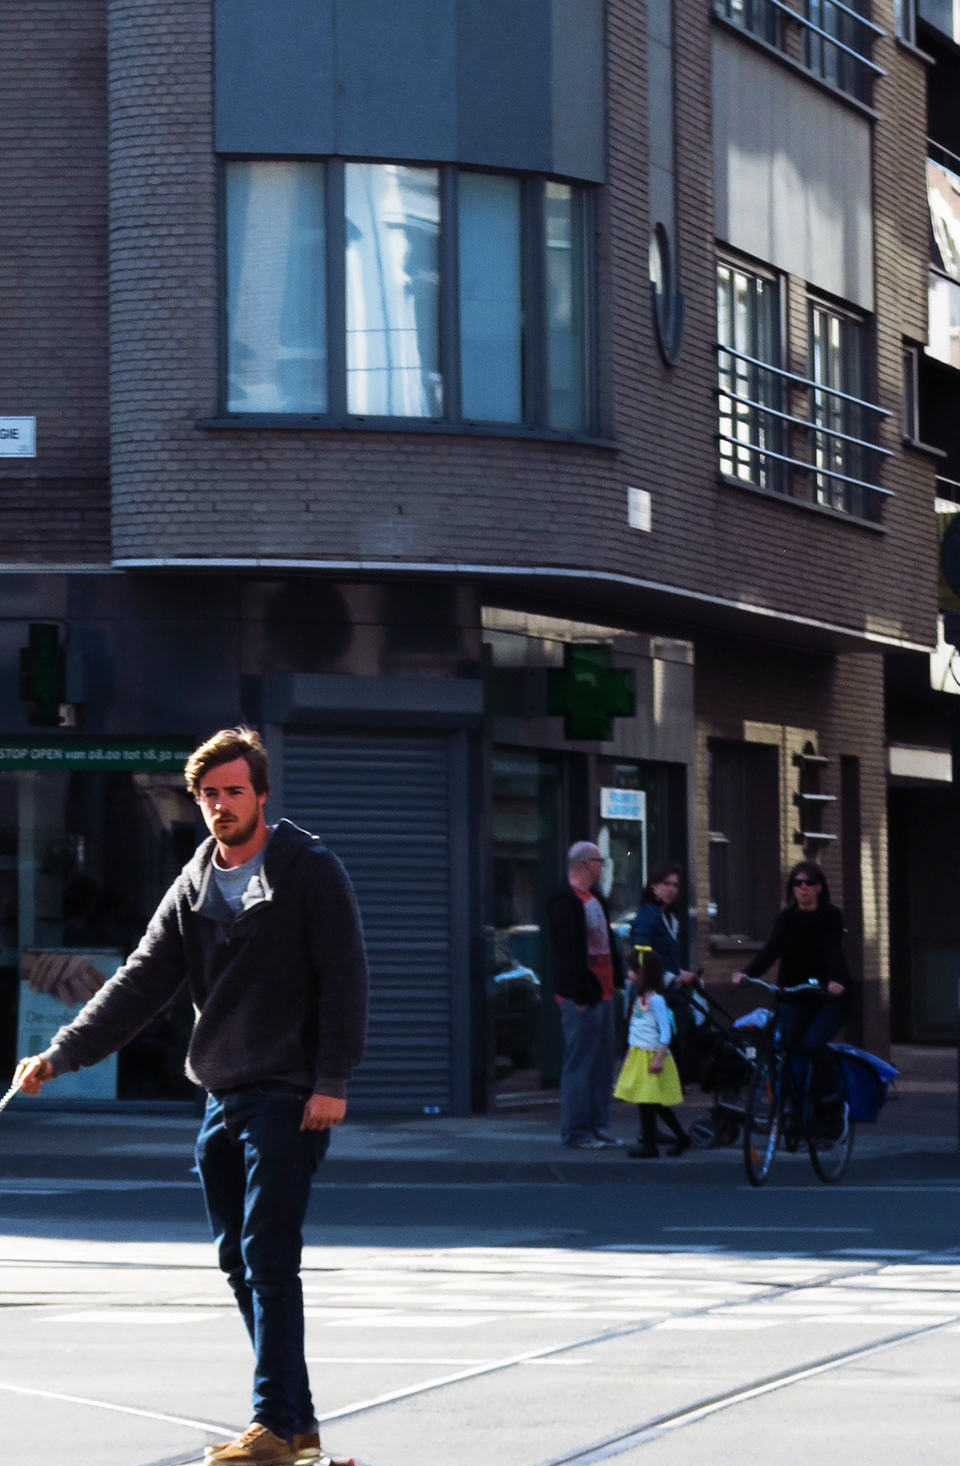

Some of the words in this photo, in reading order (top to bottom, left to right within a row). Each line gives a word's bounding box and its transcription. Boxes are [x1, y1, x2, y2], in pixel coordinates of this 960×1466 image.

[30, 748, 62, 759] OPEN
[65, 750, 86, 760] van
[121, 750, 141, 760] tot
